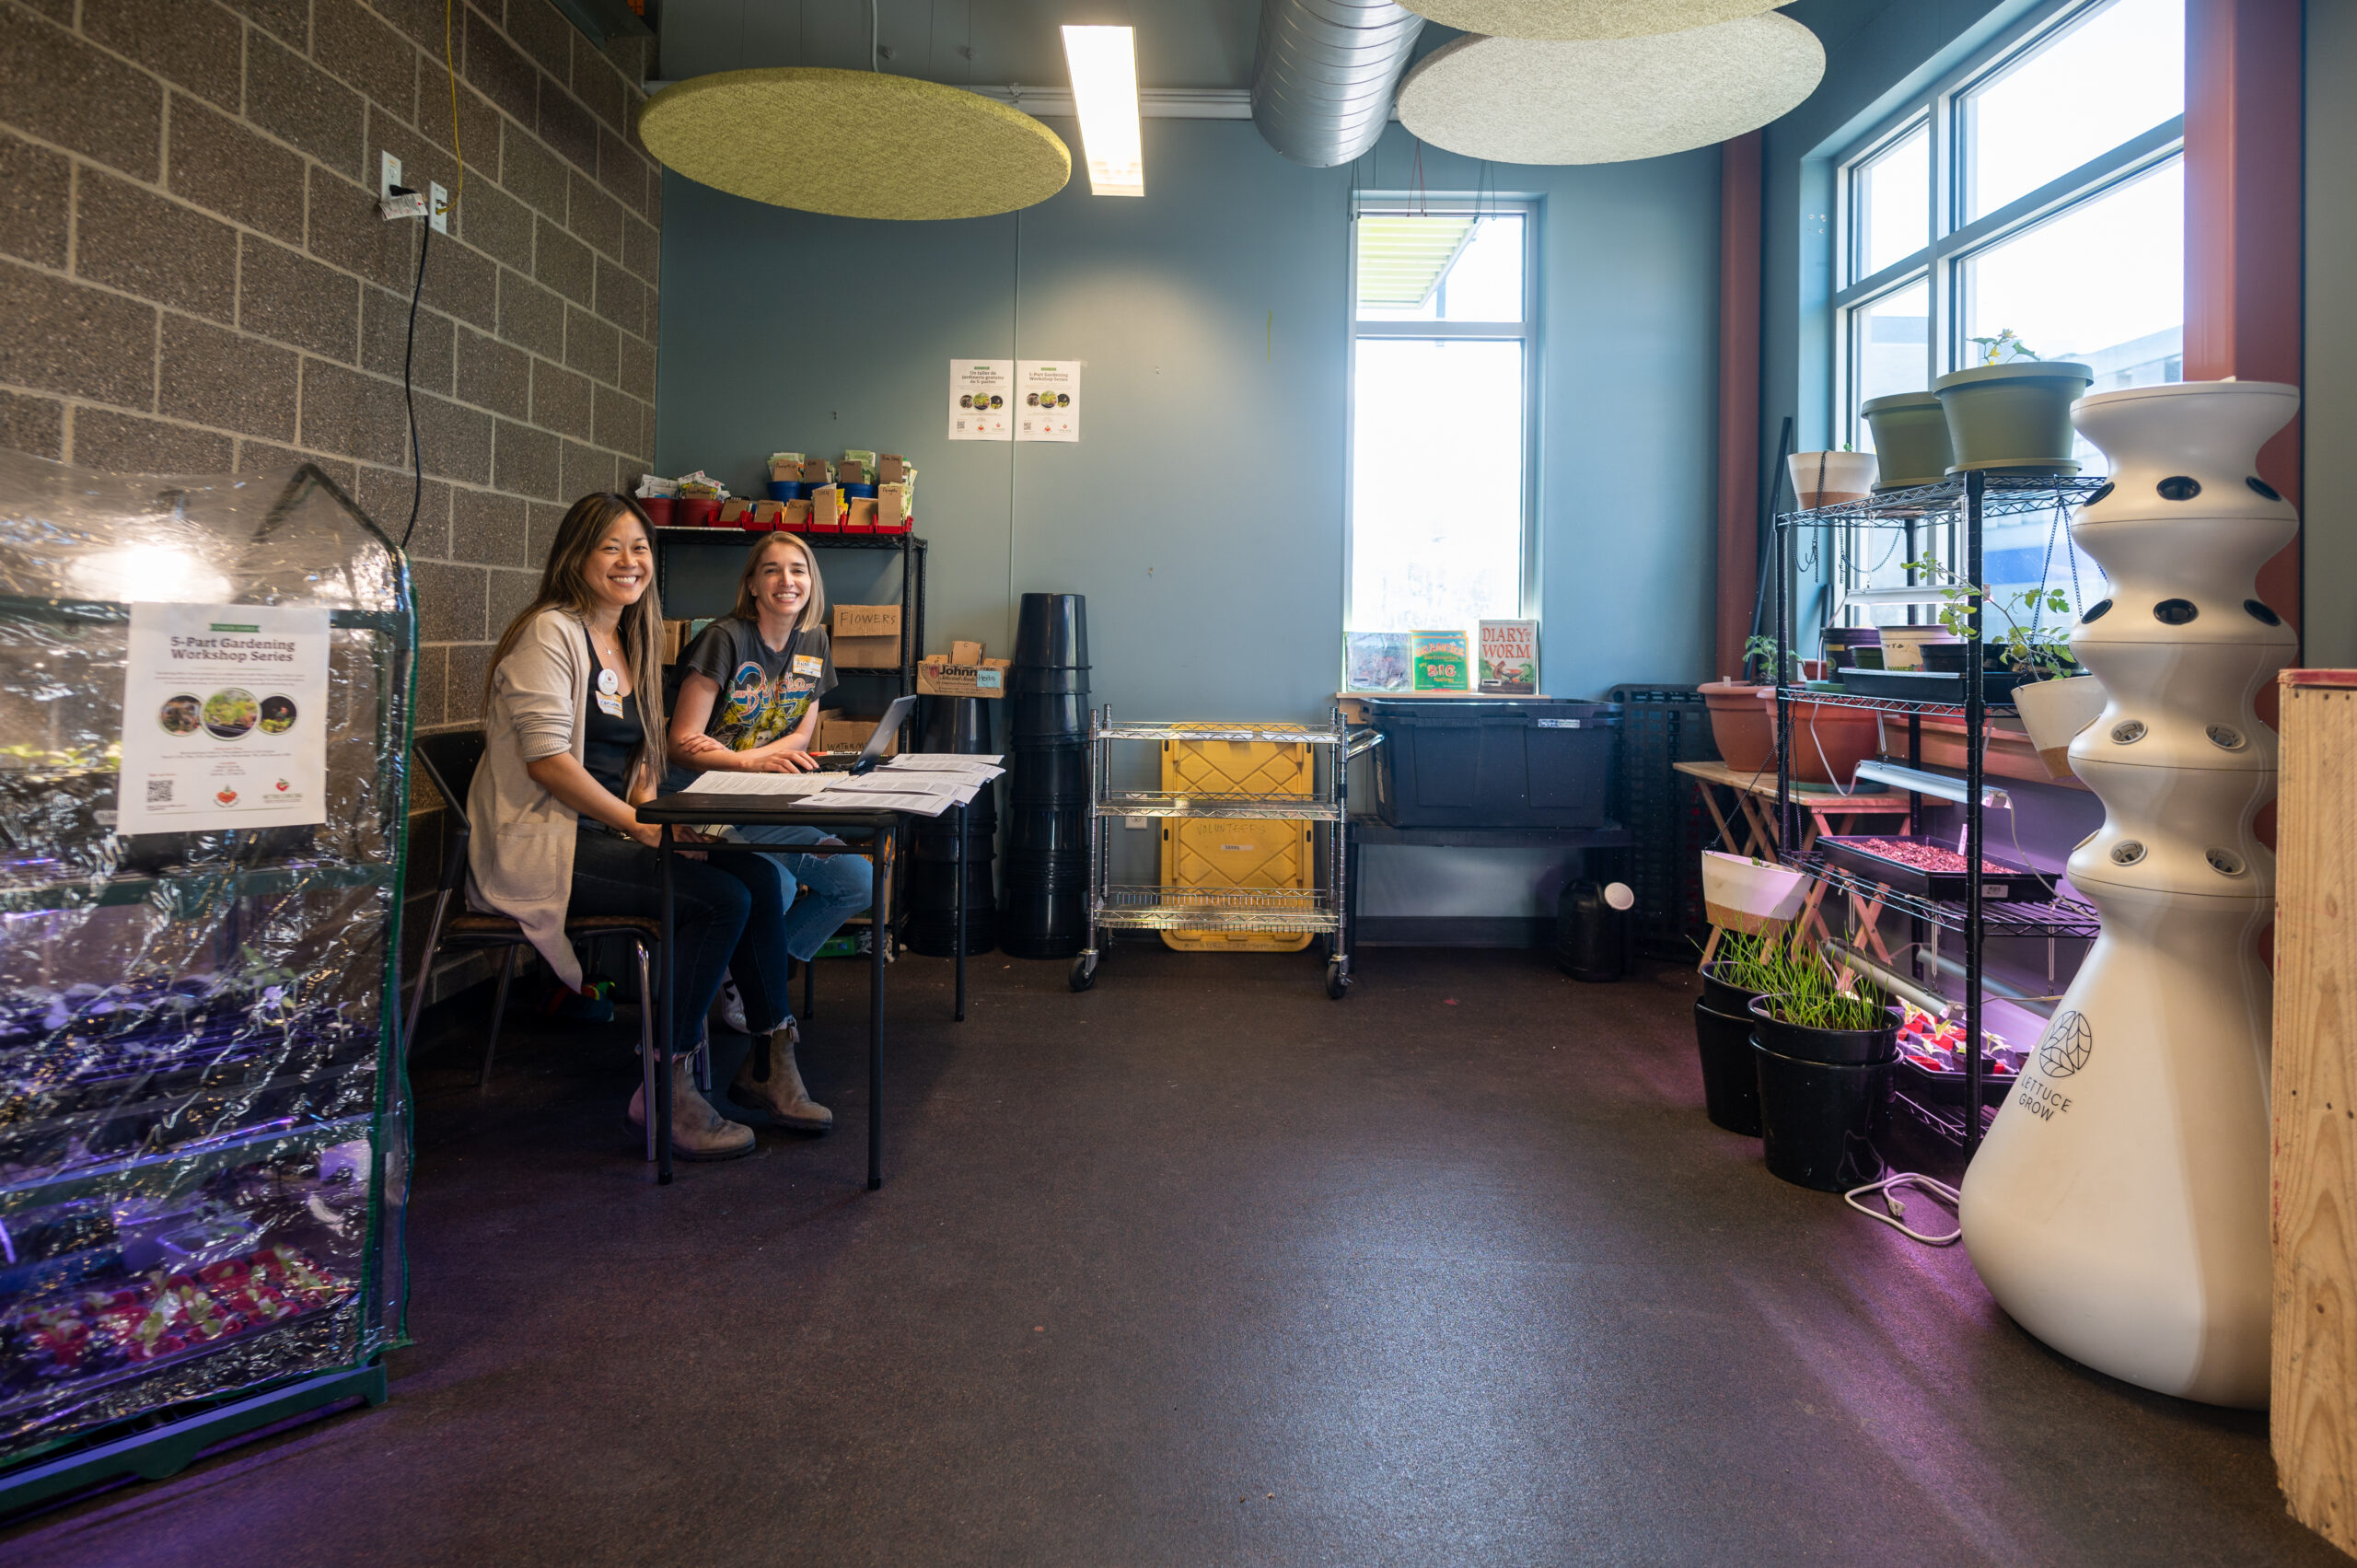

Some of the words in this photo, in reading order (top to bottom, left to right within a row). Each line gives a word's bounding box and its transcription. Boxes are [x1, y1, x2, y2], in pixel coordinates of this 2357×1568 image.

[1482, 627, 1527, 643] DIARY
[170, 635, 217, 648] 5-Part
[220, 637, 296, 653] Gardening
[1482, 644, 1531, 658] WORM
[170, 648, 248, 663] Workshop
[250, 651, 294, 662] Series
[1427, 664, 1457, 678] BIG
[2021, 1074, 2073, 1112] LETTUCE
[2019, 1093, 2055, 1121] GROW
